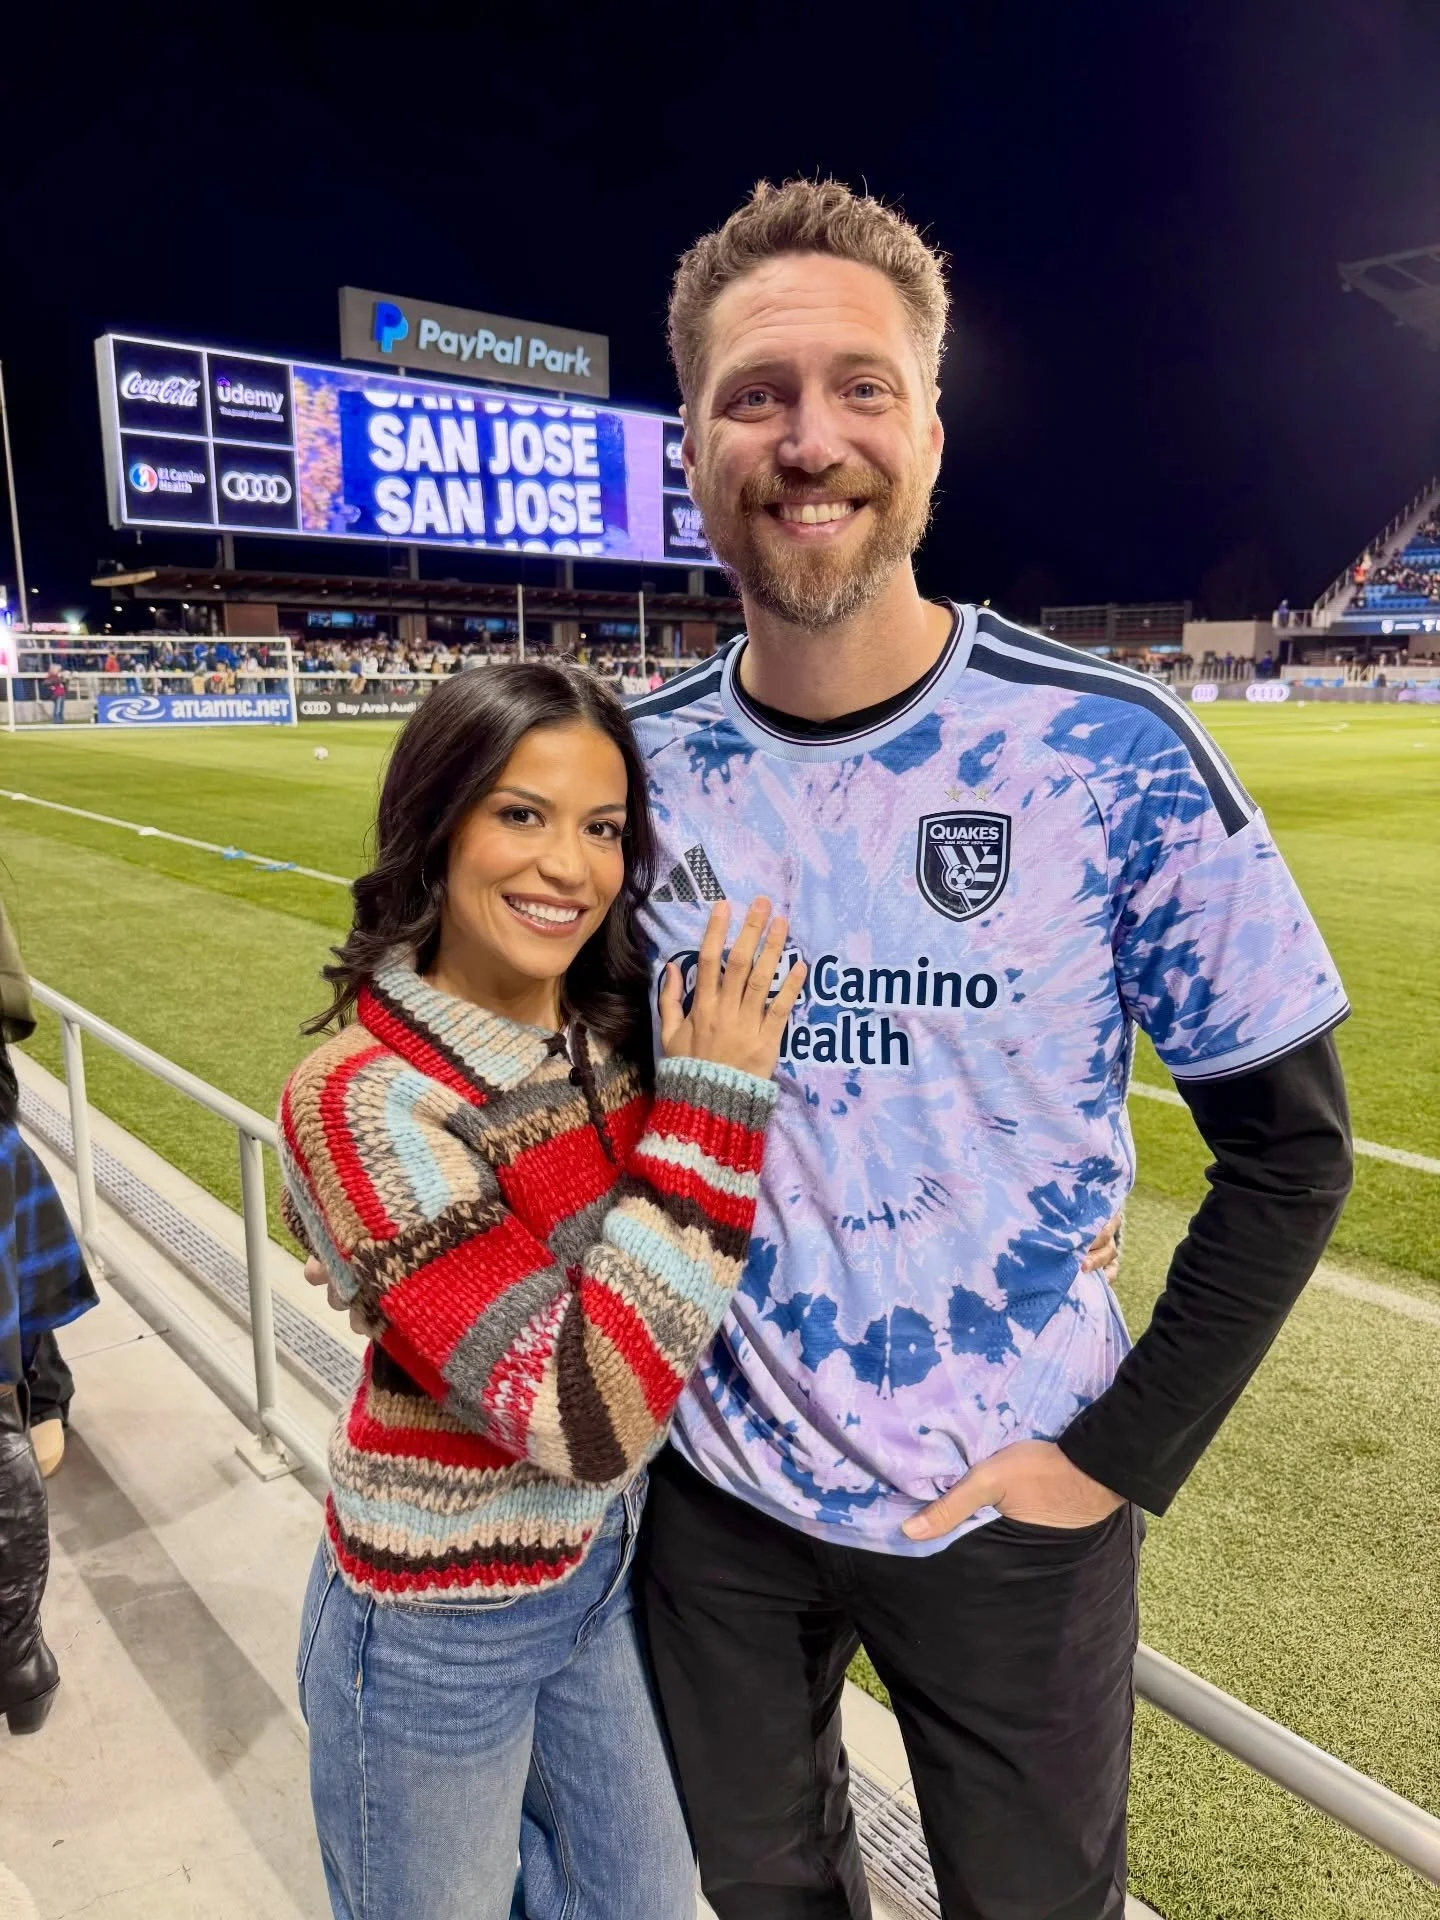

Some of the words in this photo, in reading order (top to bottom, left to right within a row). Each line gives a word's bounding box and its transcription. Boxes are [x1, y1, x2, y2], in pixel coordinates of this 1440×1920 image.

[418, 318, 523, 366] PayPal
[528, 337, 592, 377] Park
[368, 413, 481, 474] SAN
[489, 419, 600, 477] JOSE
[375, 476, 486, 535] SAN
[495, 480, 605, 536] JOSE
[336, 702, 360, 716] Bay
[361, 702, 389, 714] Area
[929, 823, 1000, 841] QUAKES
[813, 954, 998, 1009] Camino
